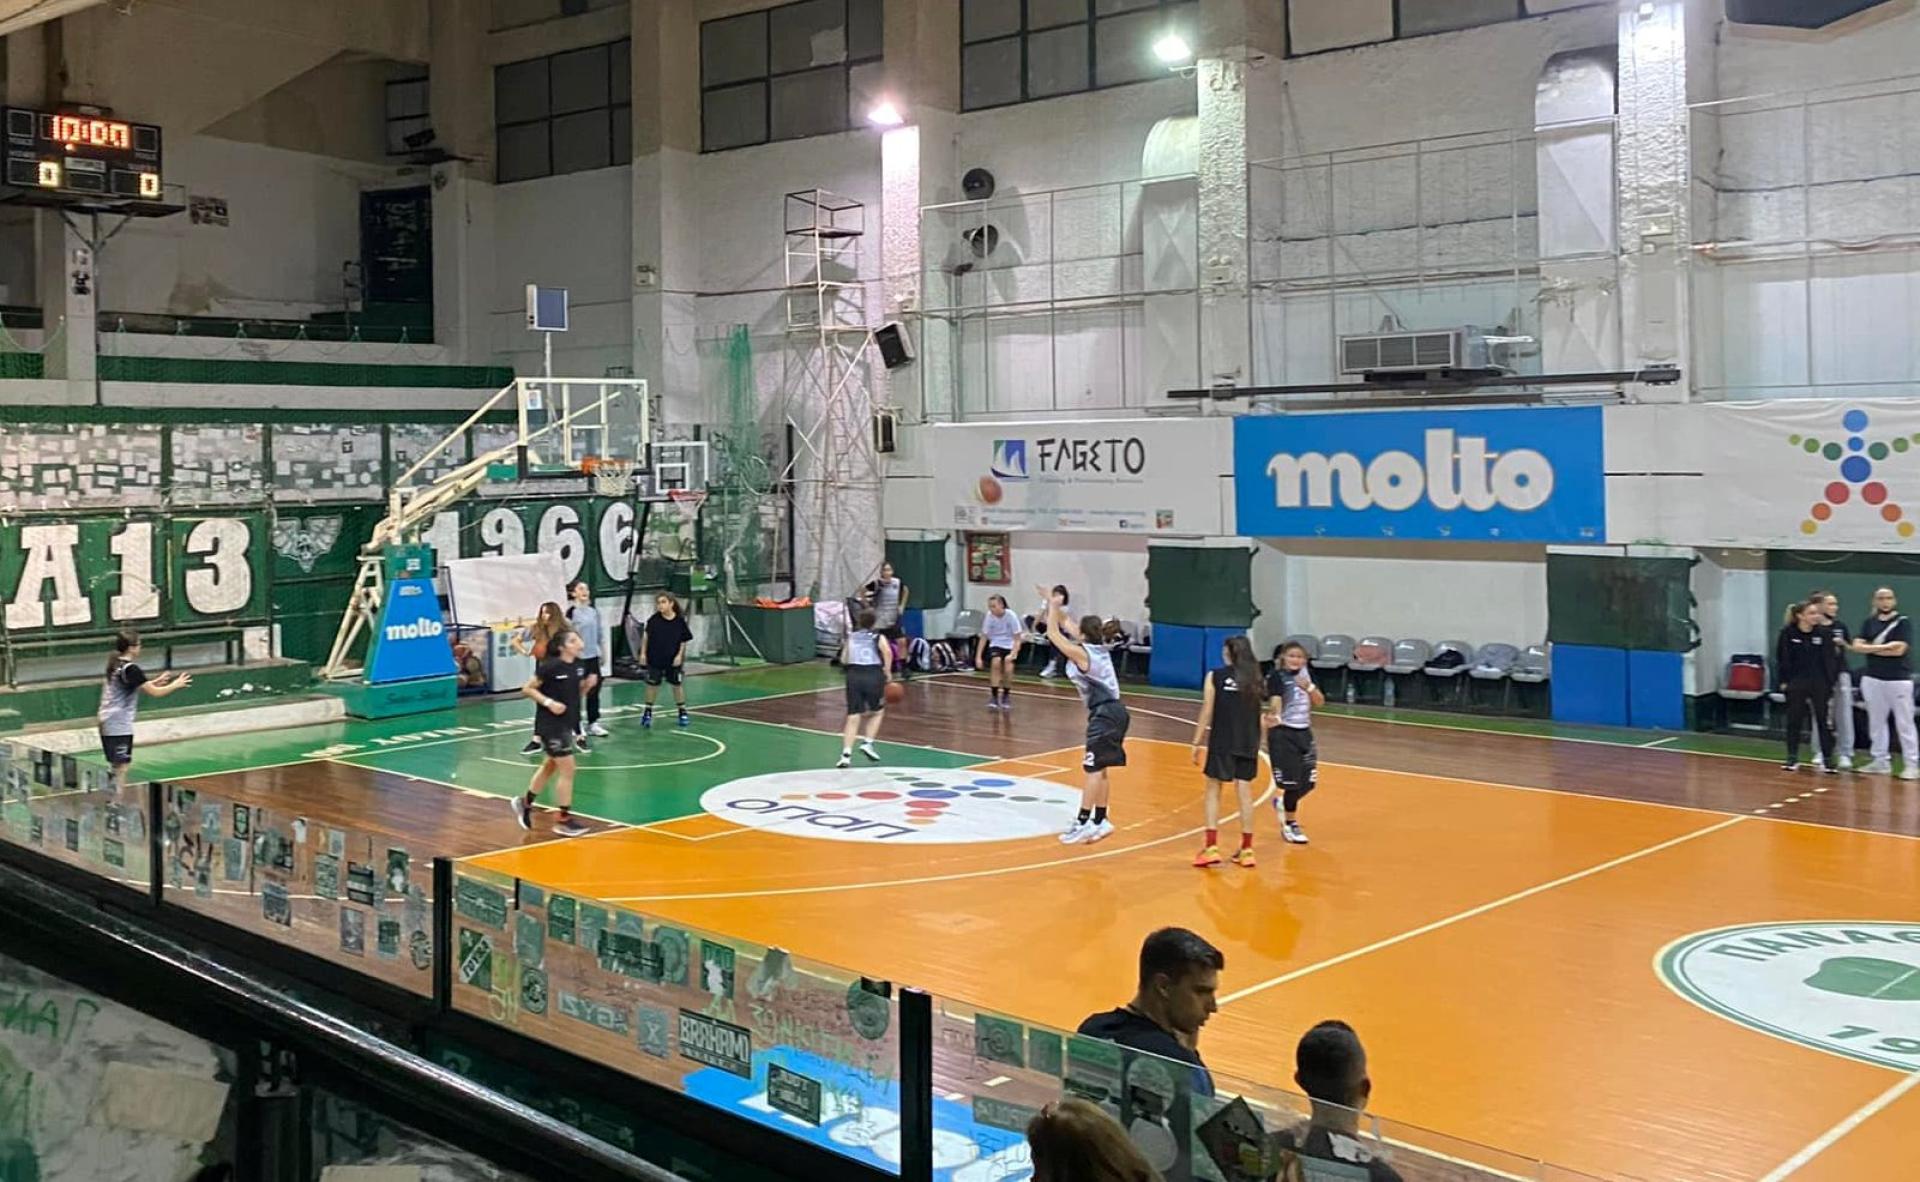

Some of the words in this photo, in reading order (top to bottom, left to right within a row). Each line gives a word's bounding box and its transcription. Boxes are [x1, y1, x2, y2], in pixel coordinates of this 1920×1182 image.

[39, 161, 59, 187] 0
[140, 173, 159, 196] 0
[1266, 428, 1555, 513] molto
[386, 617, 443, 641] molto
